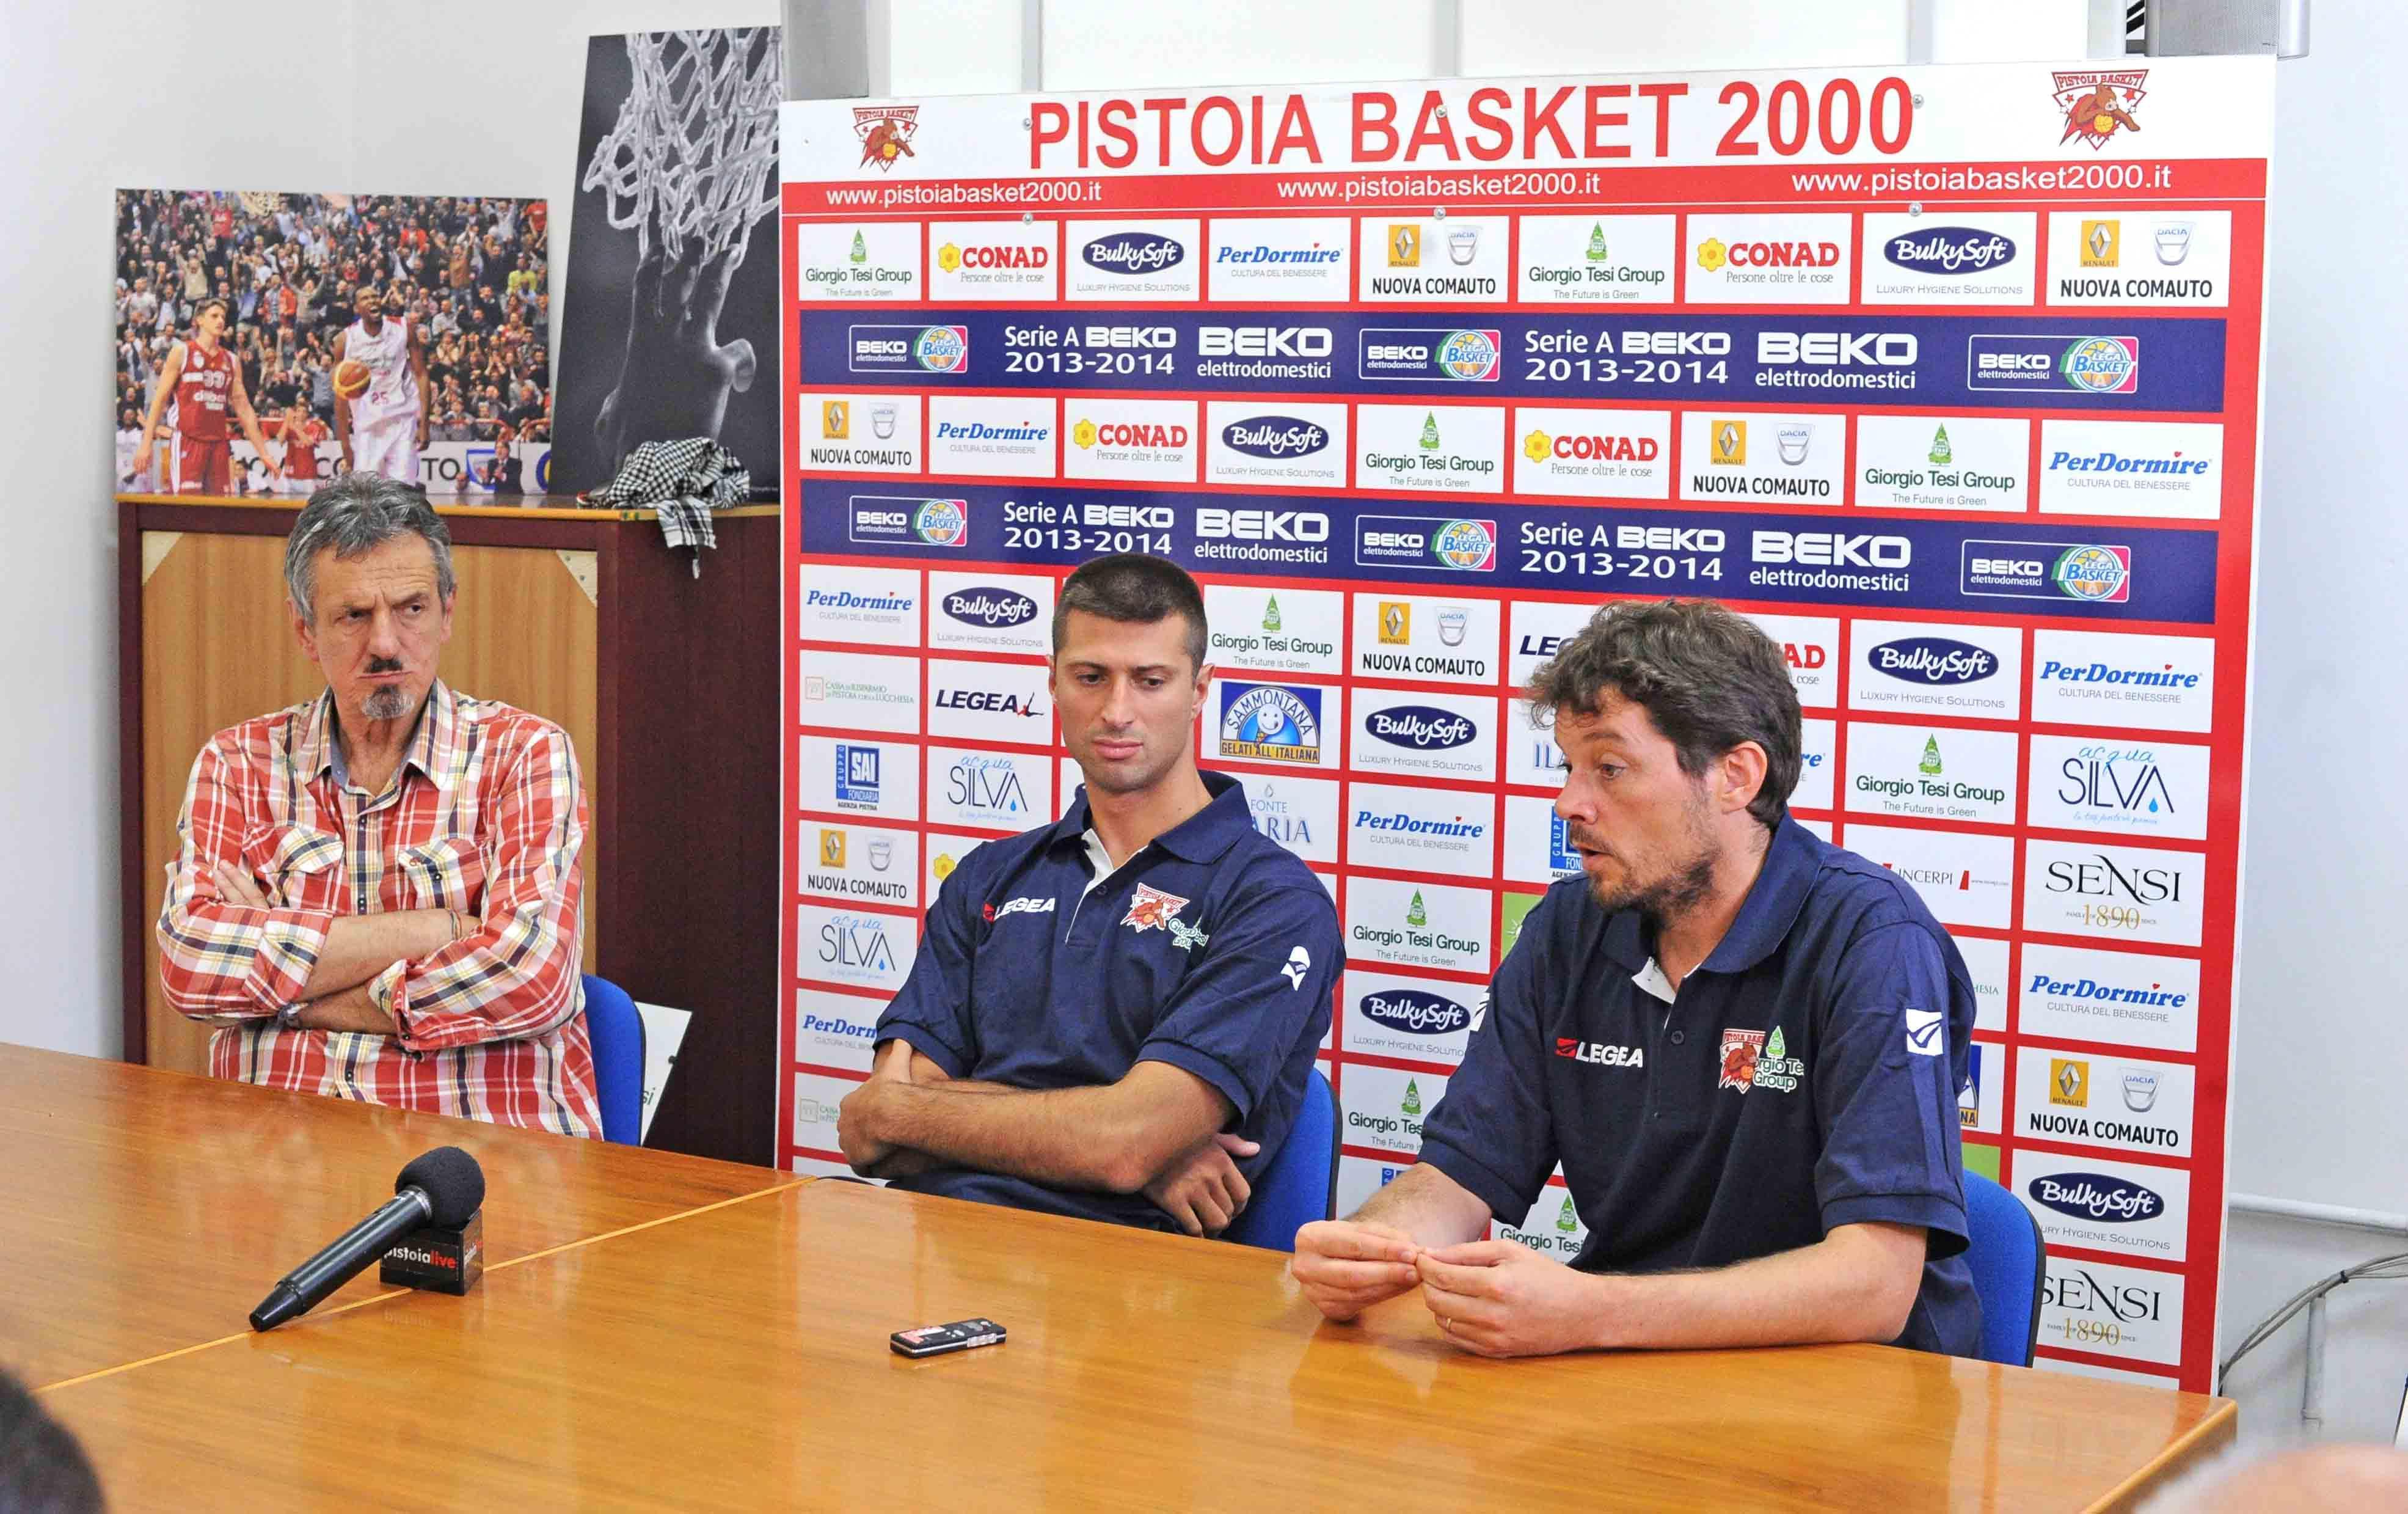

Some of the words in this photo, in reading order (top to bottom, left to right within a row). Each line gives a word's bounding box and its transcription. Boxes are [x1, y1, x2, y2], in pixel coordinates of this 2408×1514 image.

[1031, 94, 1323, 169] PISTOIA
[1351, 83, 1688, 163] BASKET
[1716, 77, 1913, 156] 2000
[1277, 172, 1600, 202] www.pistoiabasket2000.it
[1792, 165, 2171, 196] www.pistoiabasket2000.it
[826, 181, 1102, 208] www.pistoiabasket2000.it
[963, 247, 1048, 268] CONAD
[1090, 239, 1178, 270] BulkySoft
[1217, 243, 1340, 263] PerDormire
[1729, 243, 1839, 268] CONAD
[1897, 237, 2005, 269] BulkySoft
[806, 268, 847, 285] Giorgio
[850, 268, 872, 282] Tesi
[874, 268, 911, 283] Group
[1373, 278, 1422, 294] NUOVA
[1426, 277, 1496, 294] COMAUTO
[1530, 267, 1582, 285] Giorgio
[1586, 267, 1613, 282] Tesi
[1616, 268, 1665, 285] Group
[1726, 271, 1766, 284] Persone
[1770, 271, 1793, 283] oltre
[1797, 271, 1806, 283] le
[1811, 272, 1833, 283] cose
[1554, 290, 1569, 299] The
[1571, 290, 1600, 299] Future
[1603, 290, 1610, 299] is
[1612, 290, 1639, 300] Green
[1877, 285, 1914, 294] LUXURY
[1917, 285, 1960, 294] HYGIENE
[1963, 285, 2023, 294] SOLUTIONS
[2061, 280, 2121, 298] NUOVA
[2126, 280, 2213, 298] COMAUTO
[856, 340, 907, 353] BEKO
[1005, 326, 1056, 348] Serie
[1064, 329, 1079, 348] A
[1086, 328, 1176, 348] BEKO
[1199, 328, 1332, 356] BEKO
[1525, 331, 1588, 354] Serie
[1596, 333, 1614, 353] A
[1622, 332, 1730, 355] BEKO
[1368, 346, 1428, 360] BEKO
[1758, 333, 1917, 366] BEKO
[2092, 351, 2121, 361] LEGA
[1005, 352, 1174, 375] 2013-2014
[1198, 360, 1330, 379] elettrodomestici
[1525, 359, 1728, 384] 2013-2014
[1979, 354, 2050, 369] BEKO
[2074, 356, 2128, 372] BASKET
[1756, 368, 1916, 389] elettrodomestici
[1978, 369, 2049, 380] elettrodomestici
[937, 422, 1047, 441] PerDormire
[1099, 425, 1188, 447] CONAD
[1230, 422, 1321, 453] BulkySoft
[811, 449, 852, 465] NUOVA
[854, 450, 911, 467] COMAUTO
[1553, 436, 1658, 461] CONAD
[1366, 453, 1416, 472] Giorgio
[1420, 455, 1446, 471] Tesi
[1449, 457, 1494, 474] Group
[2049, 452, 2208, 476] PerDormire
[1693, 475, 1748, 494] NUOVA
[1752, 478, 1830, 496] COMAUTO
[1866, 468, 1924, 489] Giorgio
[1929, 470, 1960, 488] Tesi
[1963, 472, 2015, 492] Group
[2067, 478, 2110, 488] CULTURA
[2113, 479, 2133, 489] DEL
[2136, 480, 2190, 491] BENESSERE
[1893, 494, 1910, 503] The
[1912, 494, 1942, 505] Future
[1946, 496, 1954, 505] is
[1957, 496, 1987, 506] Green
[856, 511, 907, 526] BEKO
[1004, 502, 1056, 524] Serie
[1062, 505, 1078, 524] A
[1084, 505, 1173, 527] BEKO
[1197, 508, 1328, 540] BEKO
[1004, 527, 1172, 554] 2013-2014
[1364, 532, 1423, 548] BEKO
[1520, 522, 1583, 547] Serie
[1591, 525, 1609, 547] A
[1618, 526, 1724, 552] BEKO
[1195, 543, 1327, 563] elettrodomestici
[1753, 531, 1911, 568] BEKO
[1520, 550, 1723, 580] 2013-2014
[1972, 558, 2043, 576] BEKO
[2065, 565, 2123, 583] BASKET
[2084, 561, 2114, 571] LEGA
[1750, 567, 1910, 592] elettrodomestici
[1971, 574, 2042, 587] elettrodomestici
[807, 590, 911, 612] PerDormire
[949, 593, 1032, 623] BulkySoft
[1211, 632, 1259, 651] Giorgio
[1262, 635, 1288, 651] Tesi
[1291, 637, 1333, 656] Group
[1363, 654, 1411, 673] NUOVA
[1415, 656, 1485, 676] COMAUTO
[1878, 647, 1988, 679] BulkySoft
[2041, 661, 2199, 687] PerDormire
[936, 690, 1018, 712] LEGEA
[1860, 691, 1899, 702] LUXURY
[1901, 693, 1943, 705] HYGIENE
[1947, 696, 2005, 708] SOLUTIONS
[1227, 690, 1313, 735] SAMMONTANA
[1374, 713, 1468, 744] BulkySoft
[1222, 742, 1252, 755] GELATI
[852, 752, 876, 783] SAI
[2079, 746, 2155, 776] acqua
[948, 766, 1028, 811] SILVA
[1856, 775, 1914, 796] Giorgio
[1919, 779, 1950, 798] Tesi
[1954, 782, 2005, 804] Group
[2058, 758, 2175, 813] SILVA
[1250, 799, 1288, 813] FONTE
[1883, 801, 1902, 811] The
[1903, 802, 1933, 814] Future
[1936, 805, 1944, 815] is
[1947, 806, 1977, 817] Green
[1355, 811, 1483, 838] PerDormire
[808, 874, 848, 894] NUOVA
[851, 879, 907, 898] COMAUTO
[2045, 854, 2181, 906] SENSI
[994, 896, 1056, 921] LEGEA
[2084, 903, 2142, 930] 1890
[819, 924, 896, 971] SILVA
[1354, 926, 1403, 946] Giorgio
[1406, 931, 1433, 948] Tesi
[1436, 935, 1480, 954] Group
[2029, 975, 2186, 1008] PerDormire
[1370, 997, 1461, 1029] BulkySoft
[2048, 1002, 2090, 1014] CULTURA
[2092, 1006, 2111, 1017] DEL
[2113, 1008, 2169, 1022] BENESSERE
[1576, 1041, 1644, 1068] LEGEA
[1754, 1072, 1797, 1092] Group
[2125, 1075, 2155, 1084] DACIA
[2052, 1097, 2084, 1106] RENAULT
[1349, 1112, 1396, 1133] Giorgio
[2030, 1113, 2089, 1136] NUOVA
[2094, 1121, 2178, 1147] COMAUTO
[2041, 1180, 2156, 1219] BulkySoft
[2062, 1227, 2107, 1242] HYGIENE
[2110, 1234, 2170, 1250] SOLUTIONS
[2064, 1317, 2122, 1345] 1890
